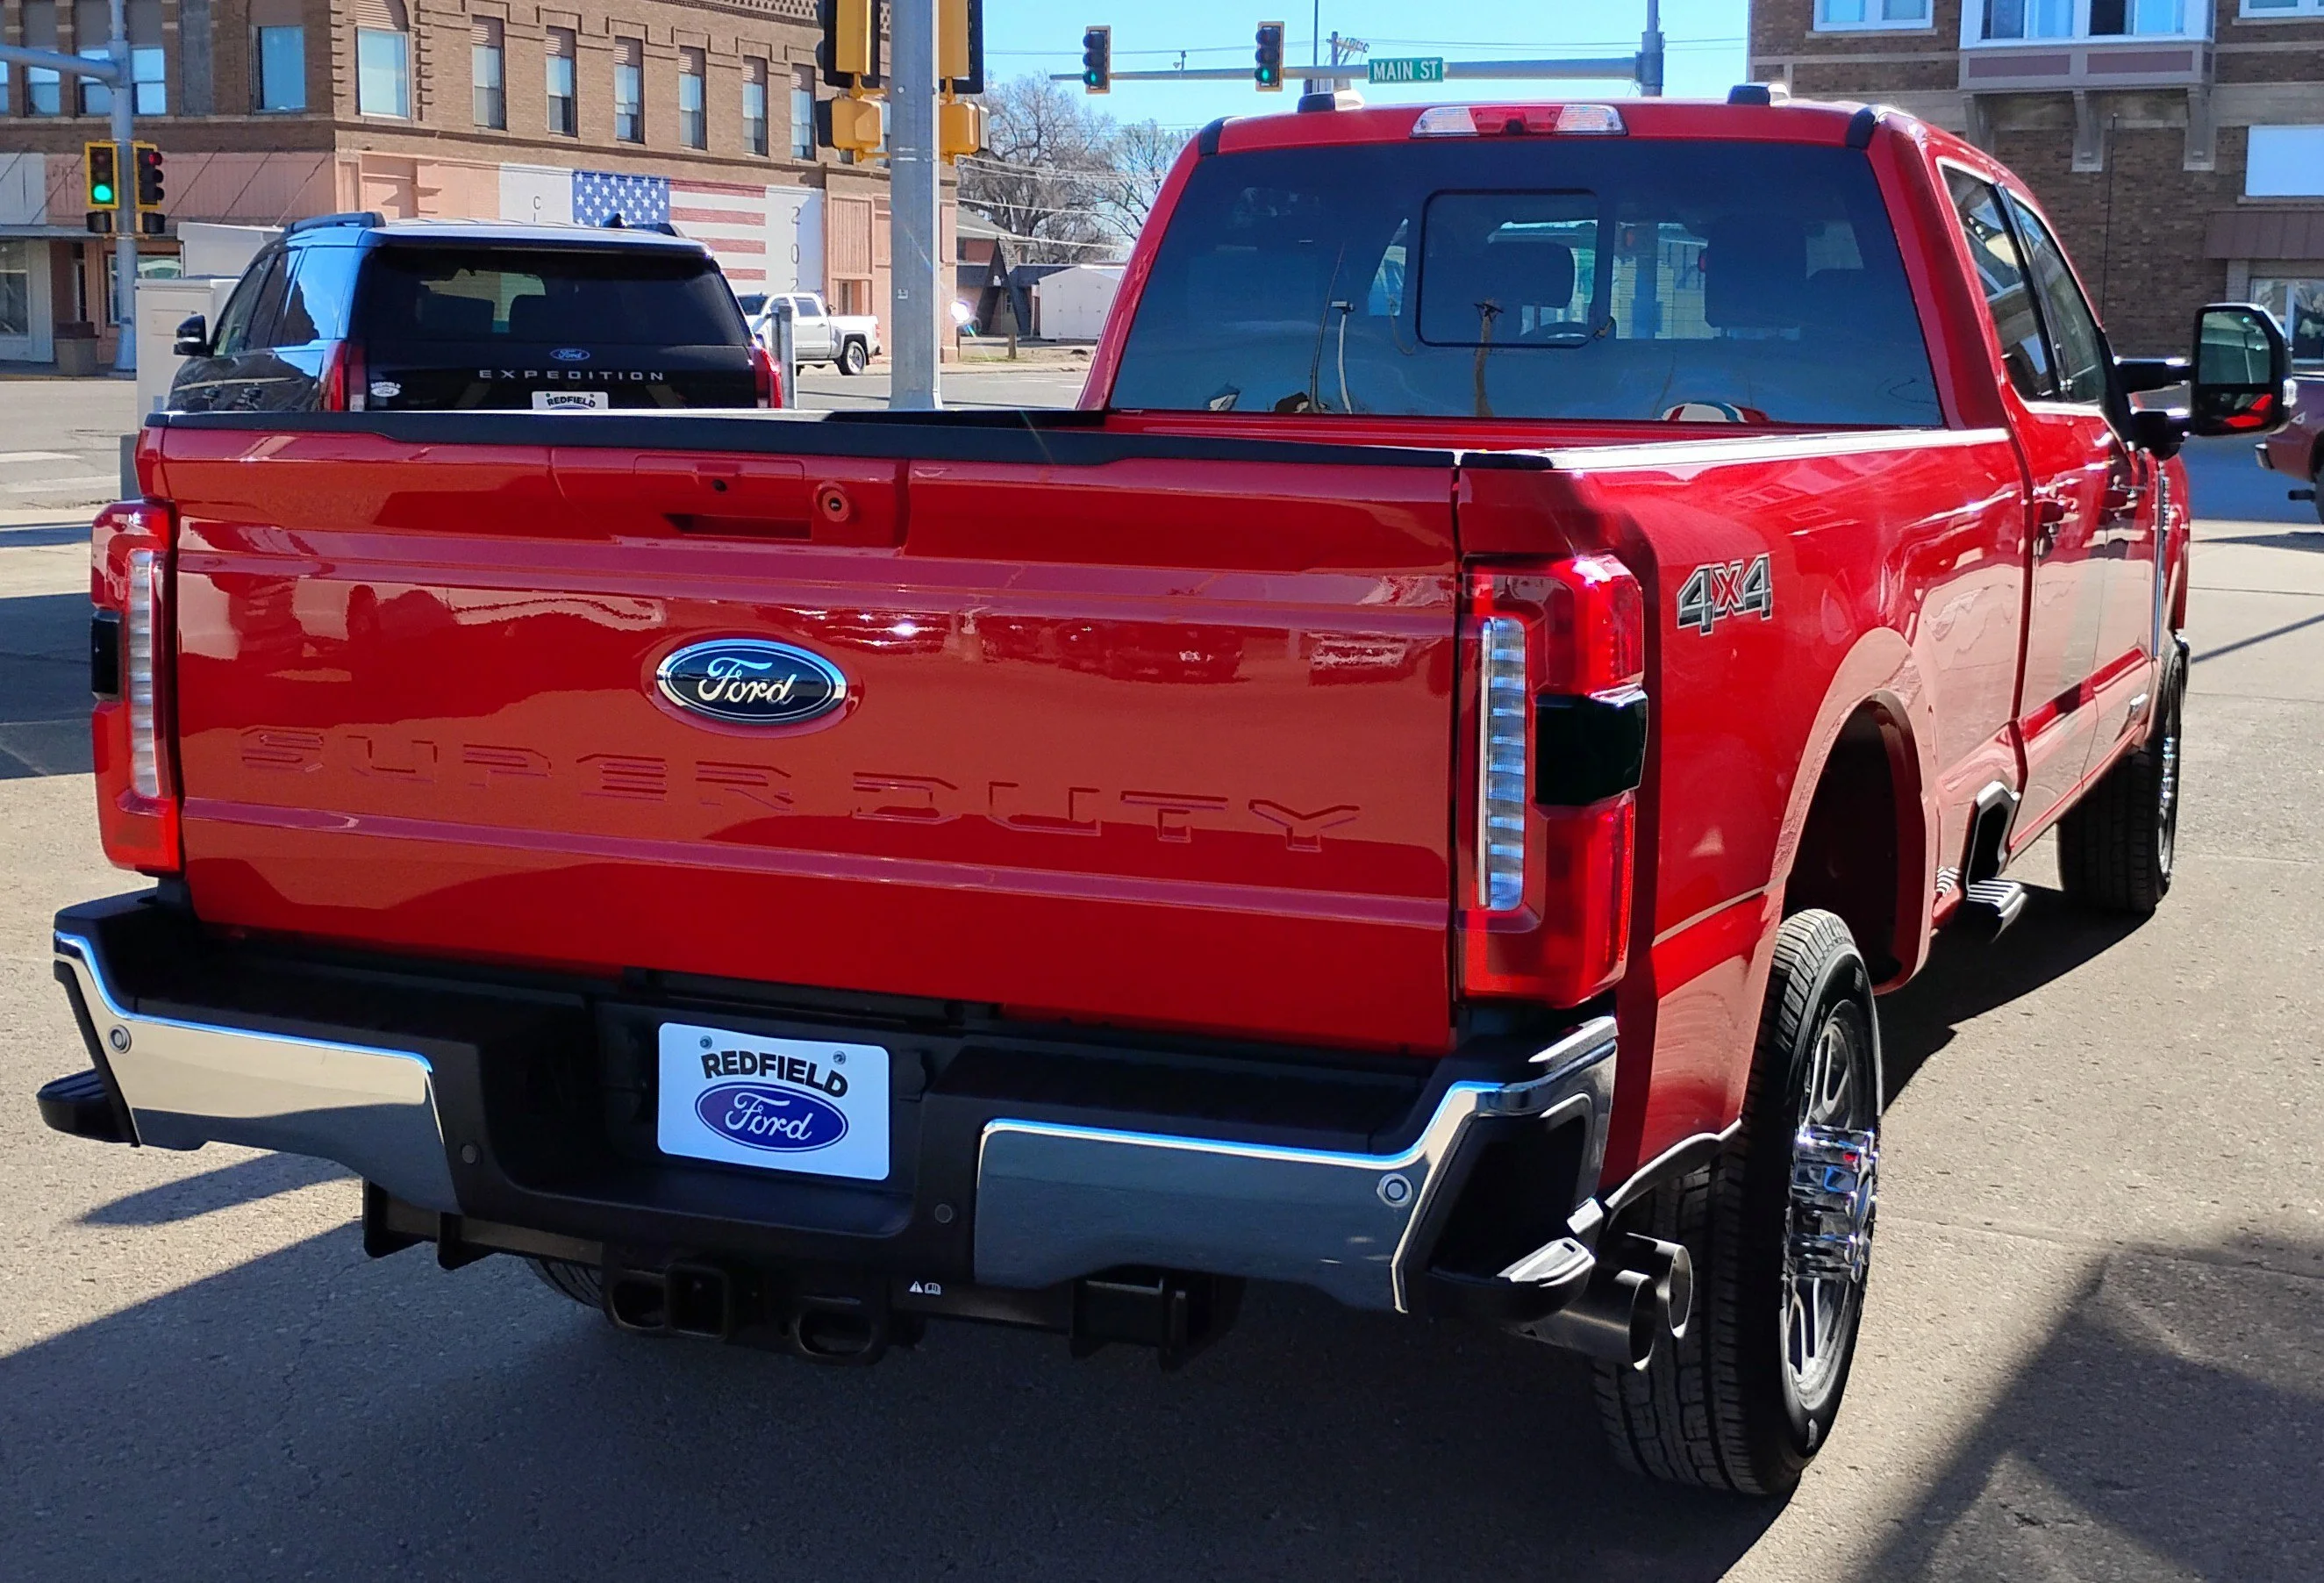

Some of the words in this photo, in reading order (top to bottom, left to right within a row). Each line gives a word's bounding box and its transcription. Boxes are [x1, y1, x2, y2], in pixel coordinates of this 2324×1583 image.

[1373, 61, 1413, 81] MAIN
[1419, 61, 1439, 80] ST
[479, 369, 664, 381] EXPEDITION
[547, 396, 597, 408] REDFIELD
[697, 656, 797, 706] Ford
[240, 725, 794, 811] SUPER
[852, 771, 1361, 852] DUTY
[700, 1049, 849, 1099] REDFIELD
[725, 1092, 814, 1141] Ford
